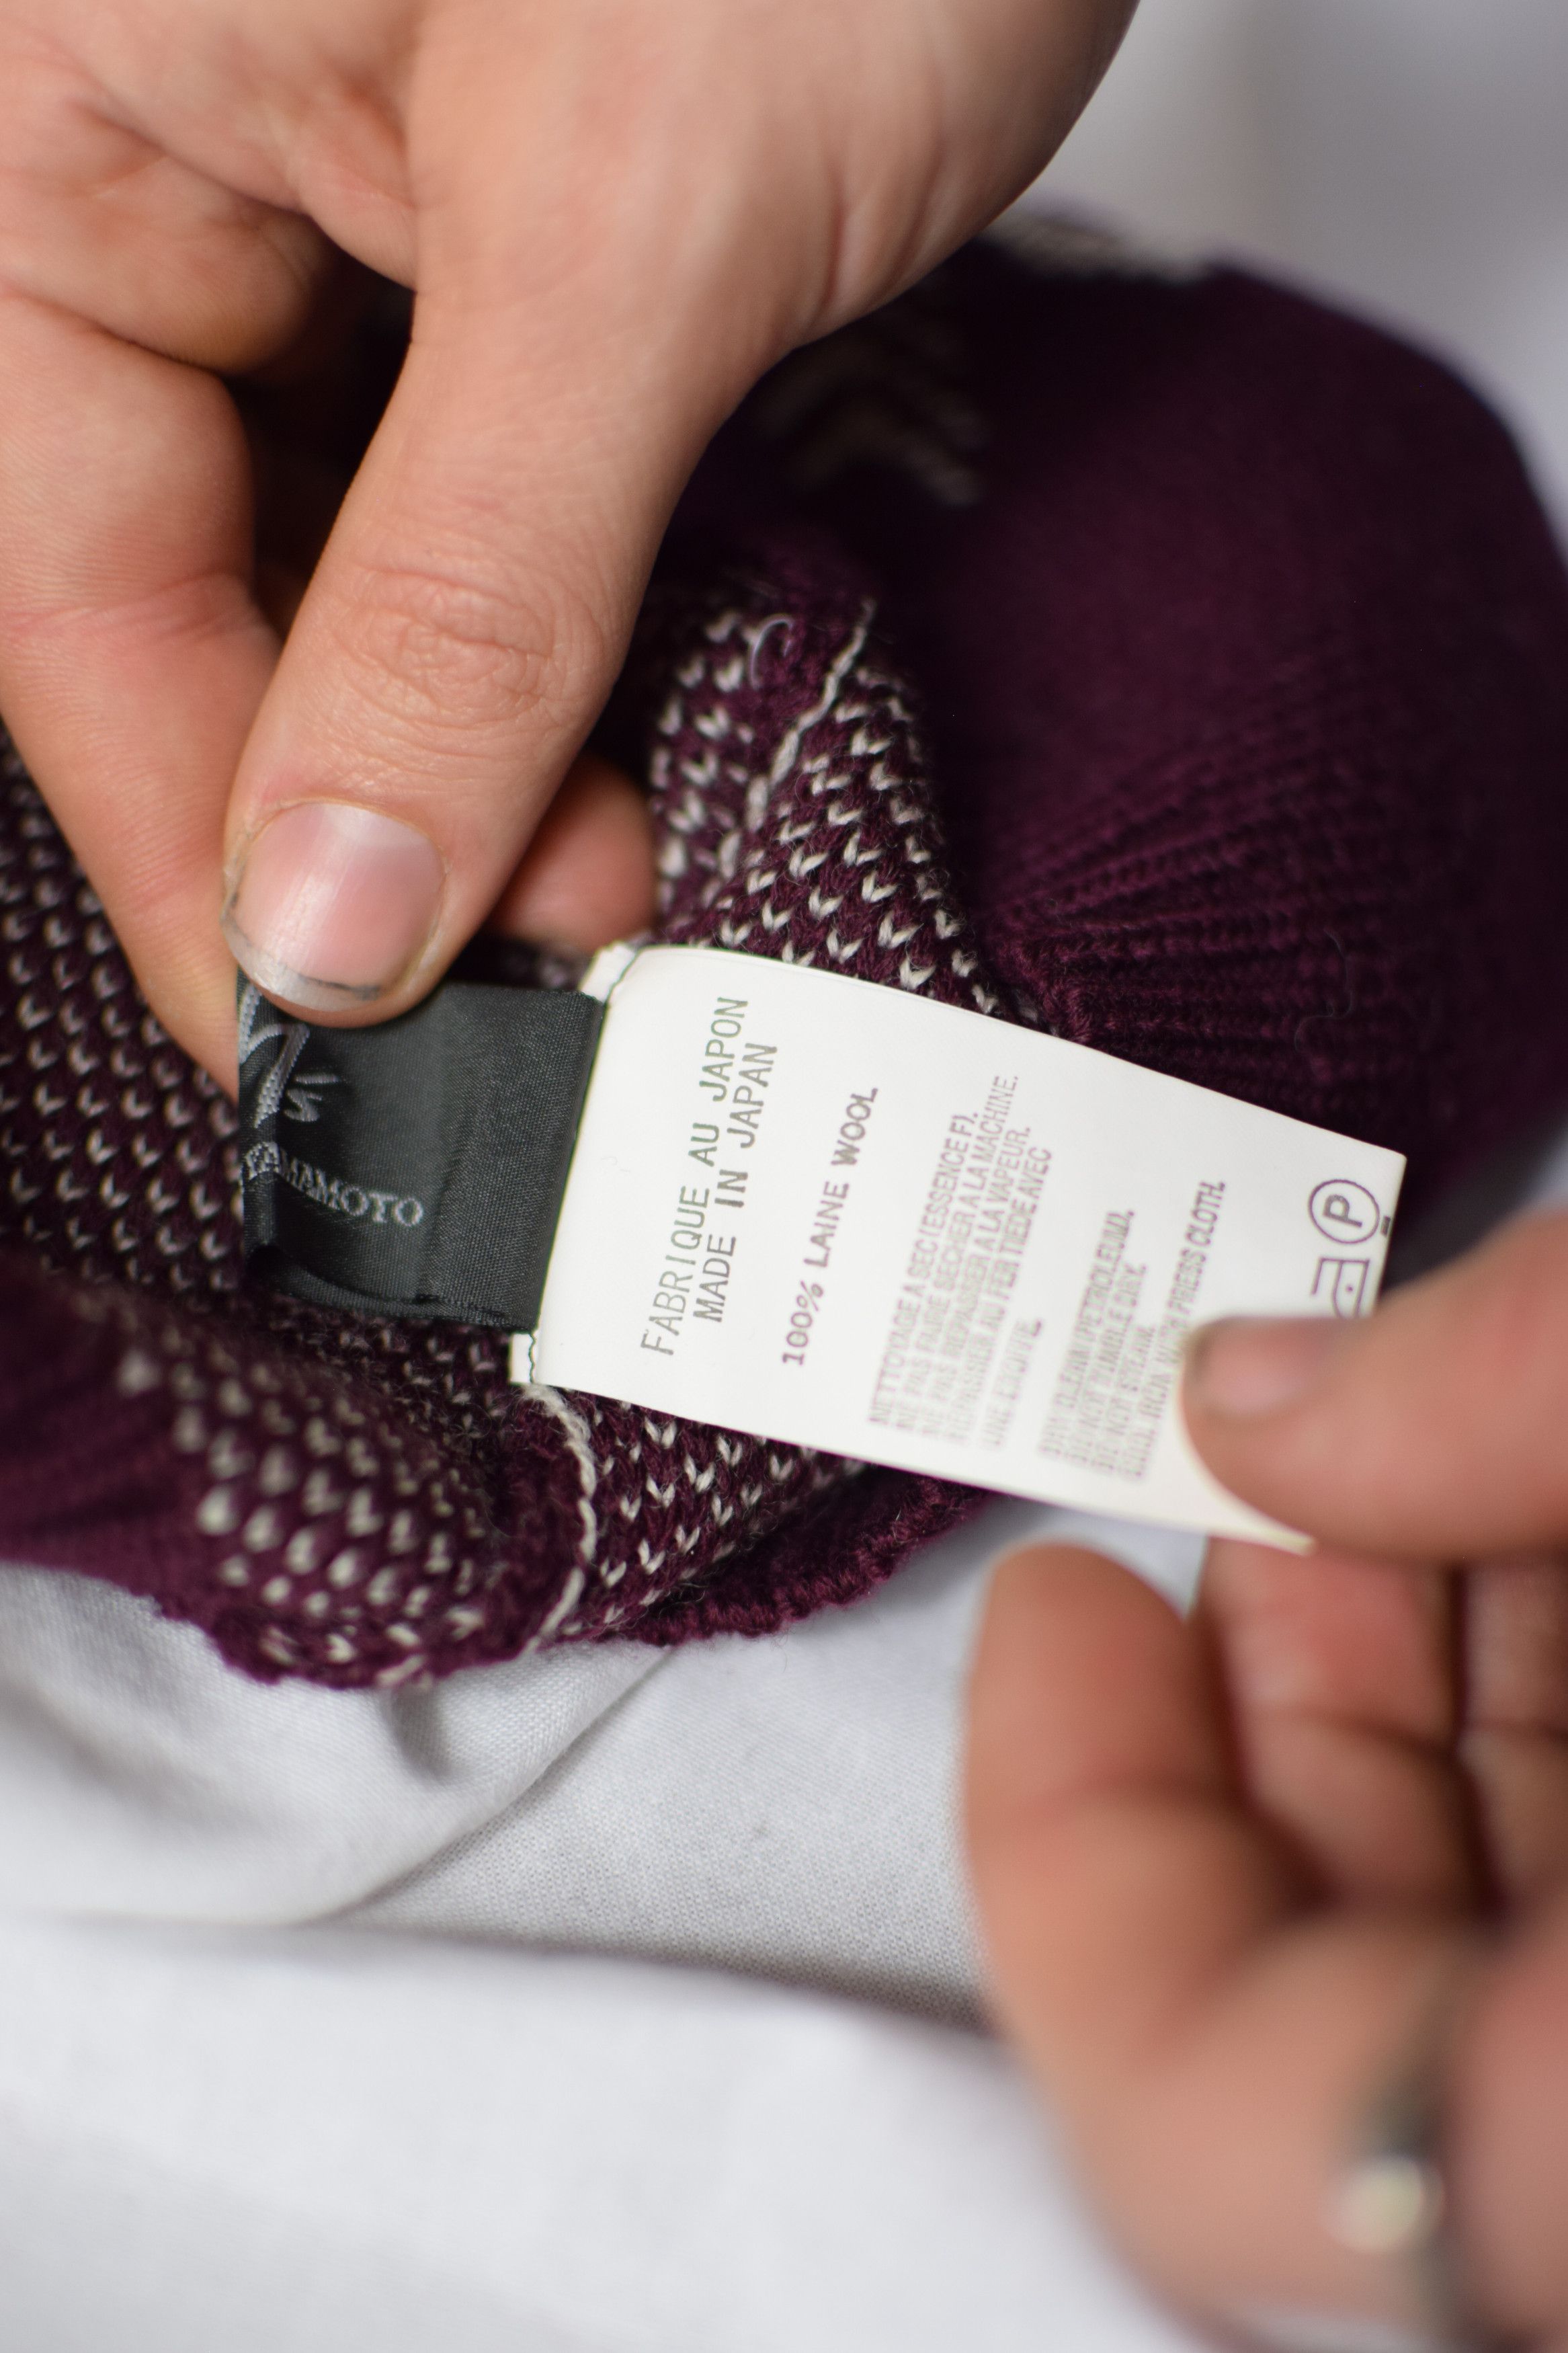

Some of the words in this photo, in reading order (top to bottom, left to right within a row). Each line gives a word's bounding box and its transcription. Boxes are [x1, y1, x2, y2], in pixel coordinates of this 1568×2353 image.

[698, 996, 749, 1102] JAPON
[727, 1043, 778, 1149] JAPAN
[971, 1071, 1019, 1162] MACHINE.
[688, 1122, 720, 1167] AU
[962, 1163, 989, 1191] LA
[987, 1122, 1031, 1205] VAPEUR.
[1016, 1144, 1053, 1198] AVEC
[714, 1169, 749, 1208] IN
[782, 1280, 824, 1366] 100%
[803, 1181, 850, 1268] LAINE
[831, 1088, 878, 1166] WOOL
[902, 1280, 925, 1297] A
[949, 1107, 979, 1137] F).
[957, 1191, 981, 1208] A
[978, 1205, 1005, 1233] LA
[1185, 1176, 1226, 1247] CLOTH.
[641, 1186, 710, 1355] FABRIQUE
[693, 1234, 737, 1322] MADE
[973, 1234, 996, 1251] A
